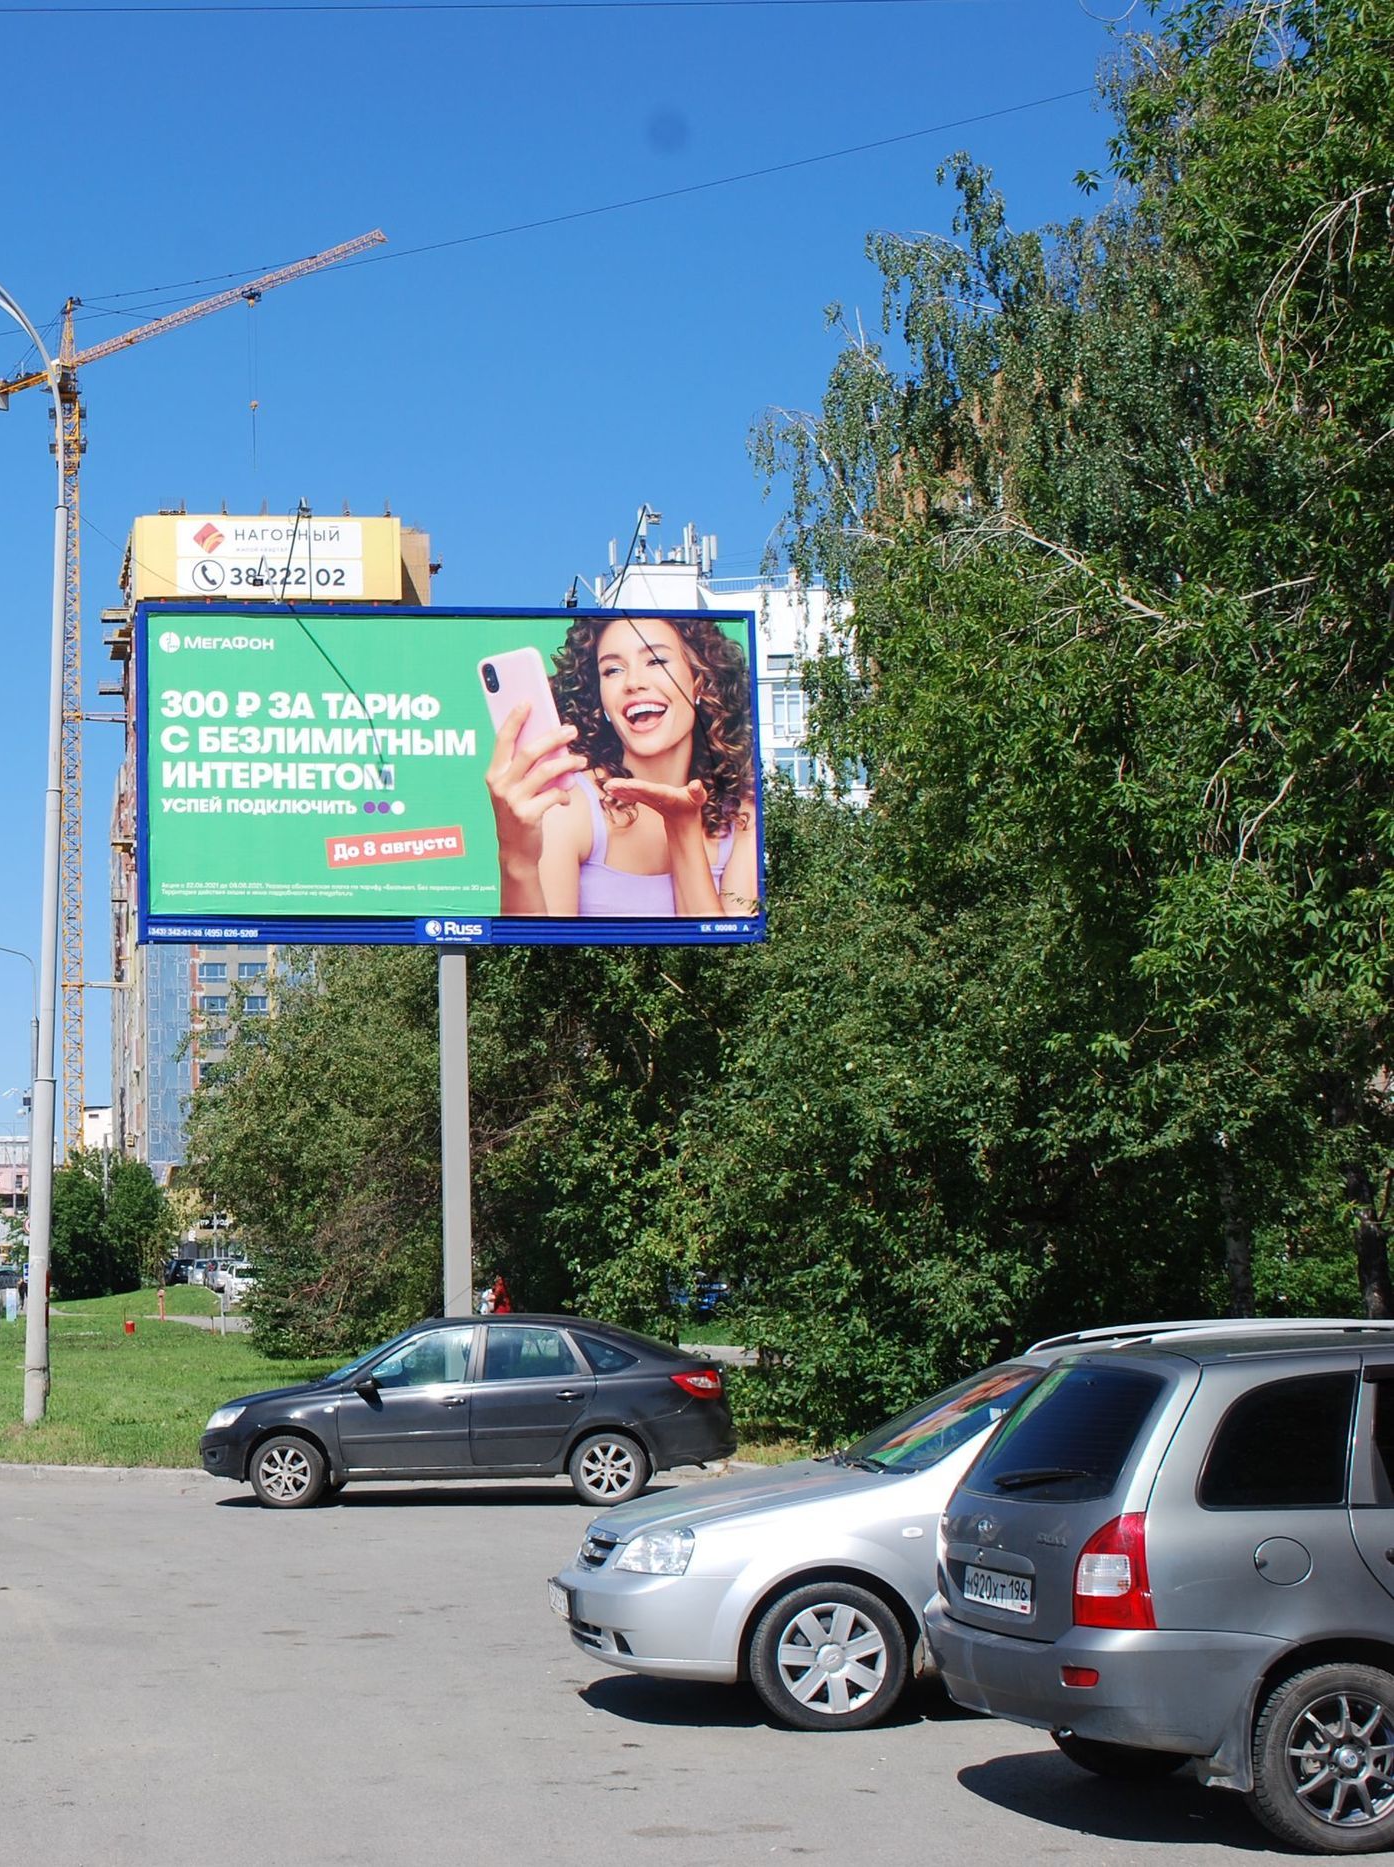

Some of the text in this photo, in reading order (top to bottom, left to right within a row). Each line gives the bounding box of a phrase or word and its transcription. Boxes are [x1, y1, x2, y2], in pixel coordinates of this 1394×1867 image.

[234, 525, 341, 542] НАГОРНЫЙ
[315, 568, 346, 587] 02
[160, 689, 228, 718] 300
[268, 691, 315, 720] ЗА
[321, 692, 441, 721] ТАРИФ
[160, 725, 477, 756] С БЕЗЛИМИТНЫМ
[162, 761, 396, 791] ИНТЕРНЕТОМ
[161, 795, 358, 816] УСПЕЙ ПОДКЛЮЧИТЬ
[333, 835, 458, 862] До 8 августа
[444, 921, 483, 936] Russ
